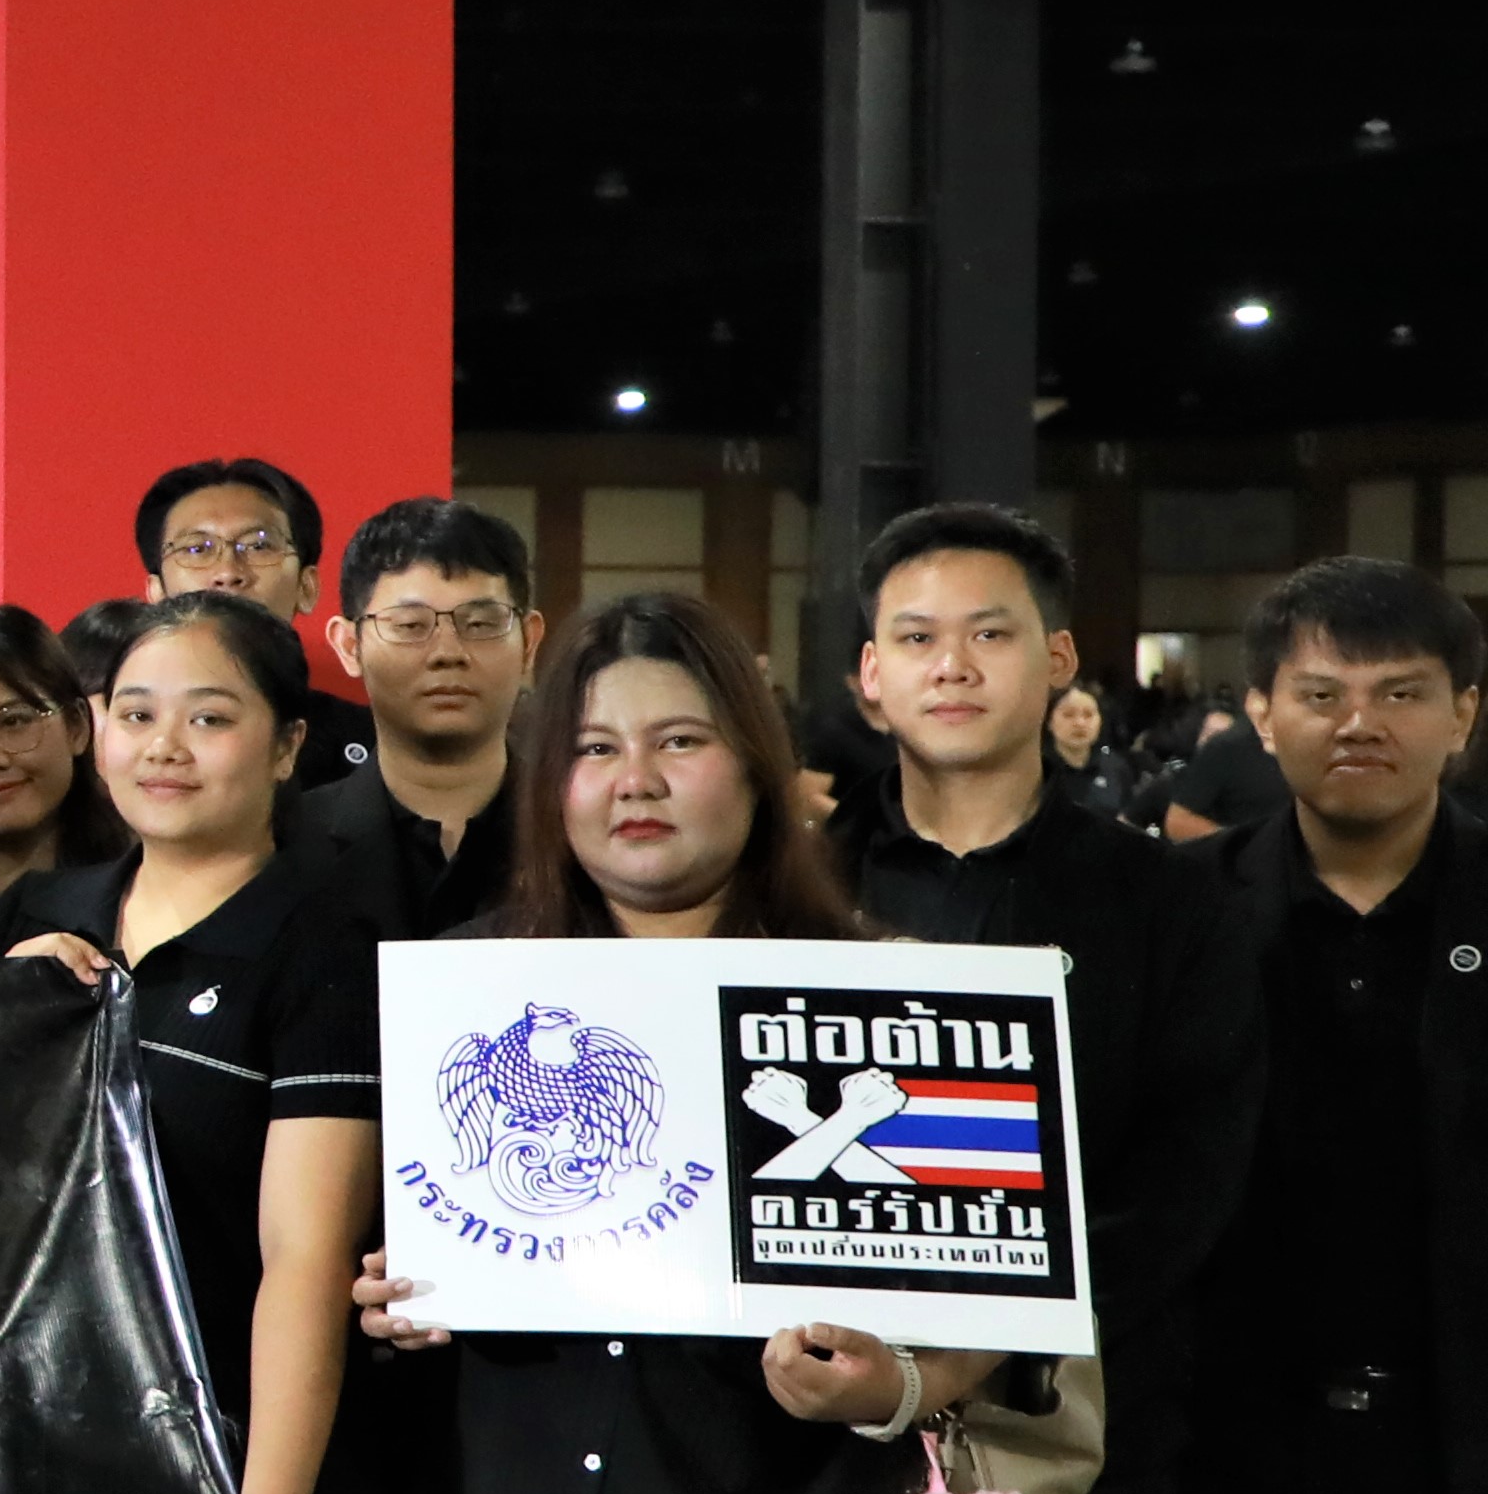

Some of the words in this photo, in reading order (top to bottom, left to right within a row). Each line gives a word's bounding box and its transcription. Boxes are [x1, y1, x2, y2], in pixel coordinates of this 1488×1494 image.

[739, 997, 1034, 1072] ต่อต้าน
[750, 1189, 1046, 1238] คอร์รัปชั่น
[757, 1235, 1045, 1267] จุดเปลี่ยนประเทศไทย
